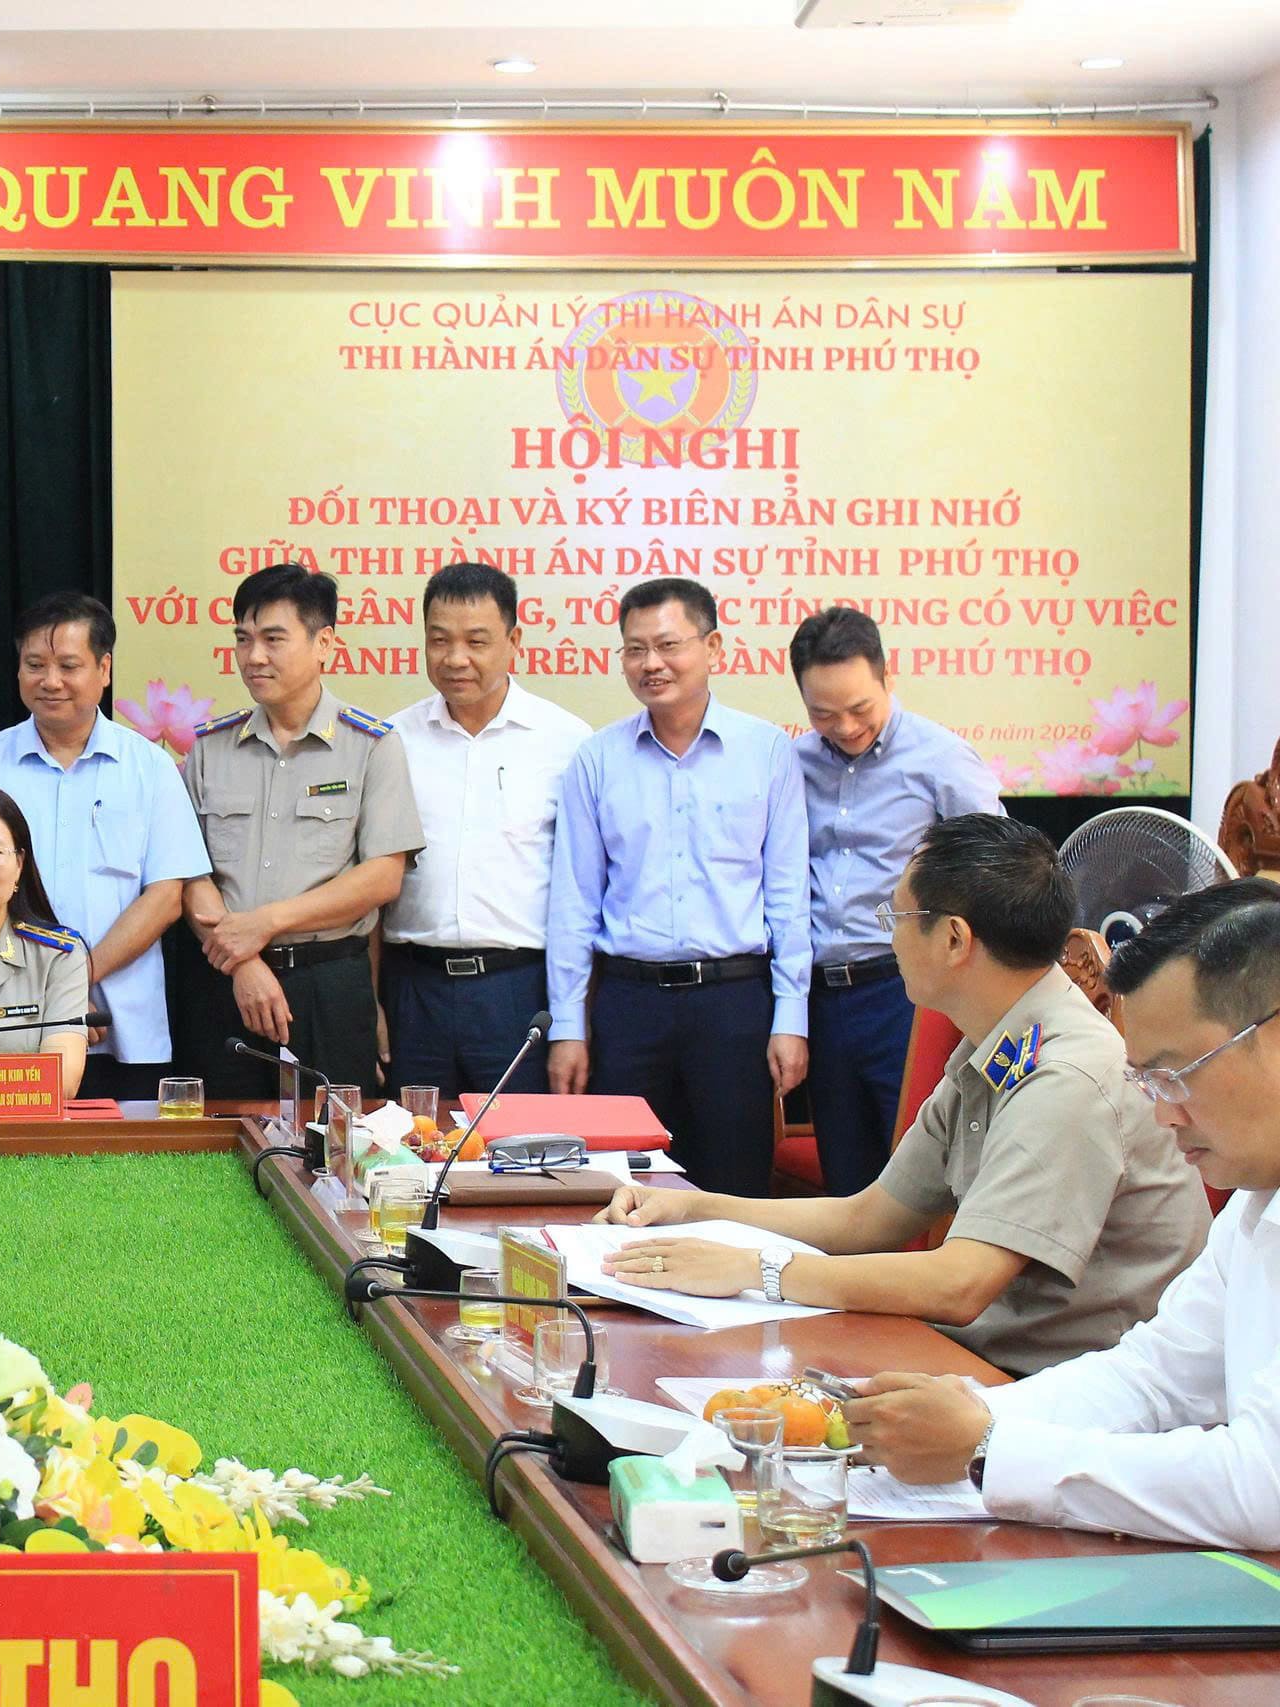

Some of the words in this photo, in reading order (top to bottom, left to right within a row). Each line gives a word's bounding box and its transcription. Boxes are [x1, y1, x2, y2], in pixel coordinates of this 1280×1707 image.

[320, 167, 561, 229] VINH
[586, 147, 860, 231] MUÔN
[893, 149, 1108, 230] NĂM
[349, 301, 421, 334] CỤC
[433, 293, 539, 331] QUẢN
[551, 295, 589, 328] LÝ
[598, 302, 651, 329] THI
[772, 296, 822, 329] ÁN
[835, 295, 910, 330] DÂN
[922, 301, 967, 336] SỰ
[339, 346, 402, 370] THI
[412, 336, 517, 371] HÀNH
[526, 337, 576, 370] ÁN
[586, 336, 661, 371] DÂN
[670, 345, 718, 380] SỰ
[723, 337, 814, 371] TỈNH
[825, 338, 897, 371] PHÚ
[906, 346, 981, 380] THỌ
[511, 412, 623, 484] HỘI
[640, 428, 800, 484] NGHỊ
[288, 485, 360, 526] ĐỐI
[370, 497, 500, 535] THOẠI
[513, 486, 568, 526] VÀ
[576, 486, 632, 526] KÝ
[642, 488, 741, 526] BIÊN
[751, 488, 838, 527] BẢN
[846, 499, 919, 527] GHI
[931, 490, 1022, 527] NHỚ
[330, 547, 403, 576] THI
[544, 536, 604, 576] ÁN
[615, 537, 702, 576] DÂN
[712, 546, 769, 586] SỰ
[776, 537, 880, 577] TỈNH
[900, 540, 985, 577] PHÚ
[993, 548, 1080, 587] THỌ
[126, 585, 199, 625] VỚI
[336, 587, 416, 625] GÂN
[564, 584, 620, 626] TỔ
[960, 586, 1011, 626] CÓ
[1024, 598, 1075, 636] VỤ
[1085, 590, 1177, 636] VIỆC
[320, 636, 419, 676] ÀNH
[911, 638, 996, 675] PHÚ
[1005, 647, 1092, 686] THỌ
[972, 723, 984, 740] 6
[990, 722, 1035, 740] năm
[1039, 723, 1094, 741] 2026
